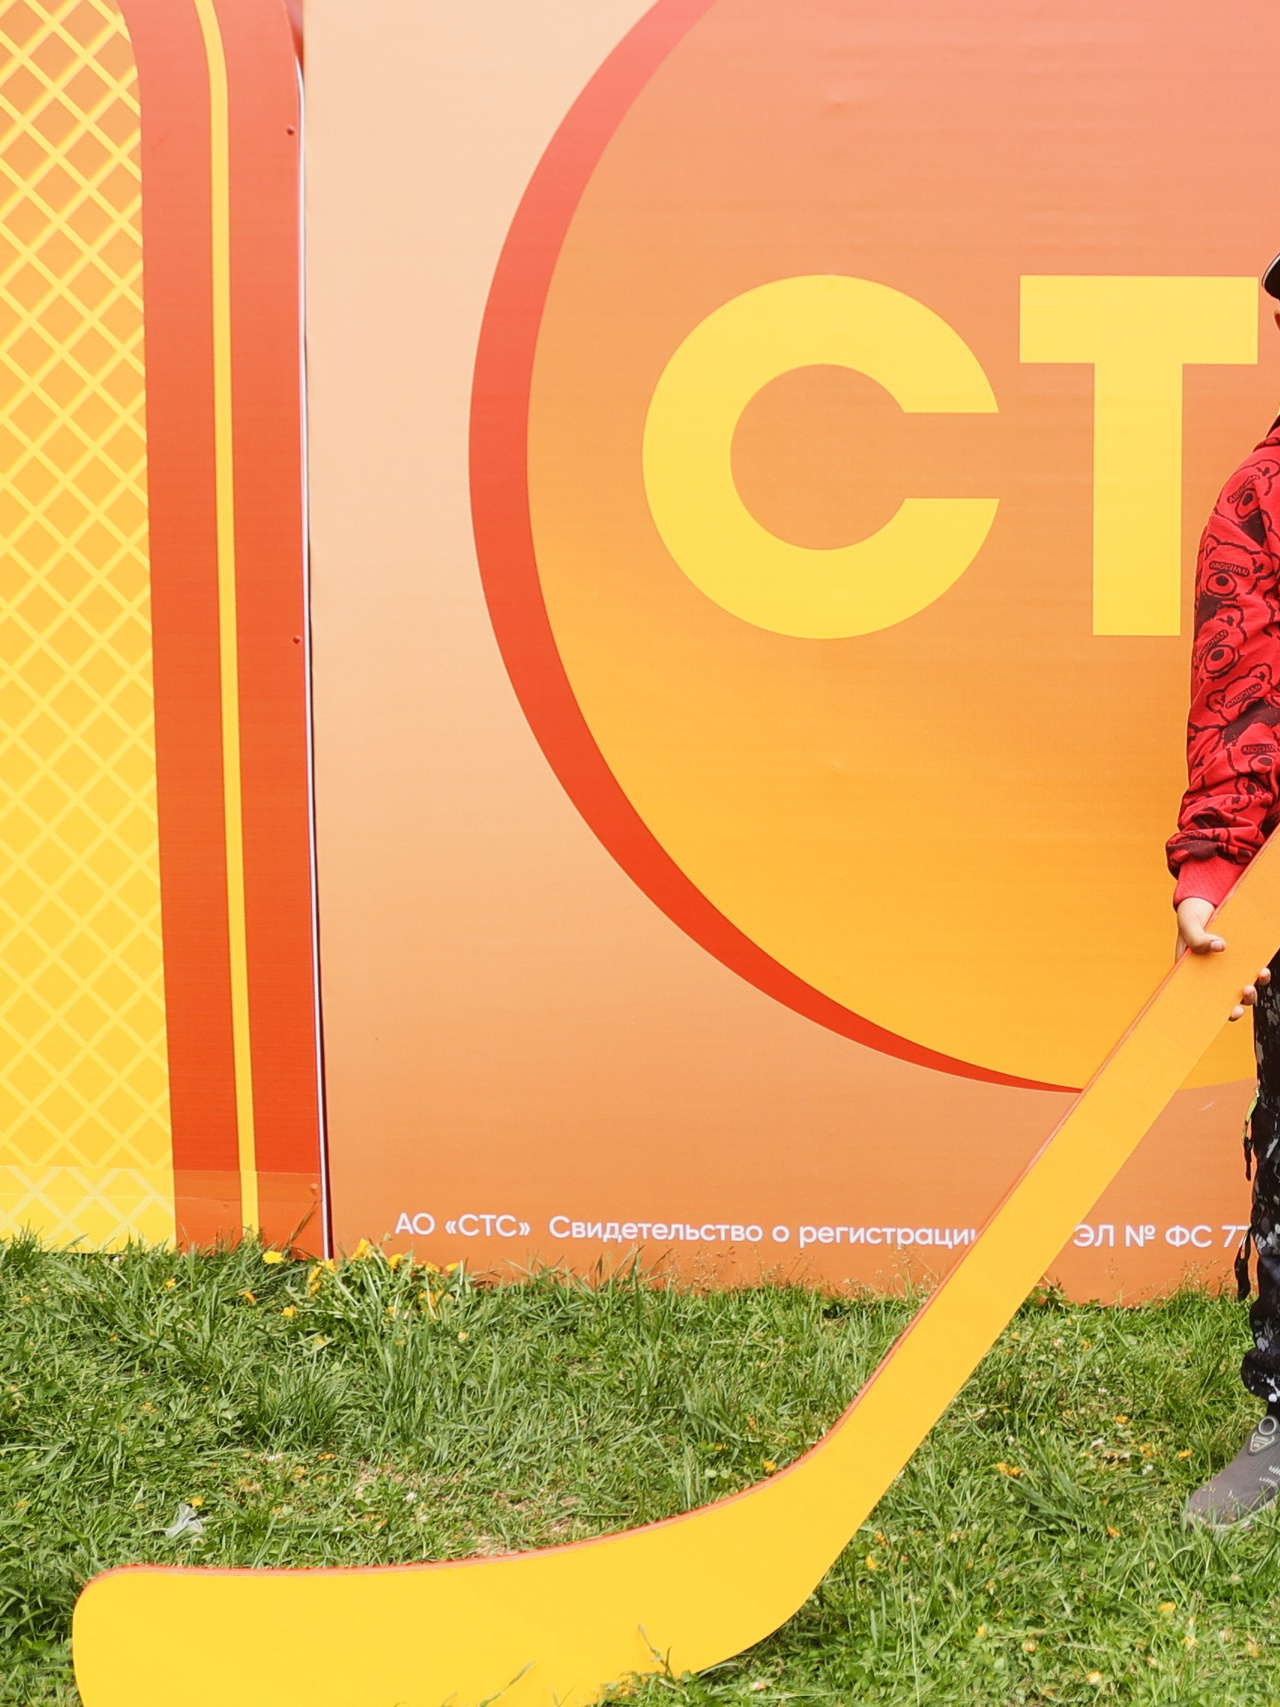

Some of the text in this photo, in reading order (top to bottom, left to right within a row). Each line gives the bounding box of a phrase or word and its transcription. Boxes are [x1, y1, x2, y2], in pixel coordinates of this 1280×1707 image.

[394, 1212, 436, 1236] АО
[445, 1213, 531, 1237] «СТС»
[548, 1215, 764, 1243] Свидетельство
[771, 1225, 790, 1243] о
[1072, 1223, 1115, 1247] ЭЛ
[1125, 1224, 1156, 1247] №
[1164, 1224, 1213, 1248] ФС
